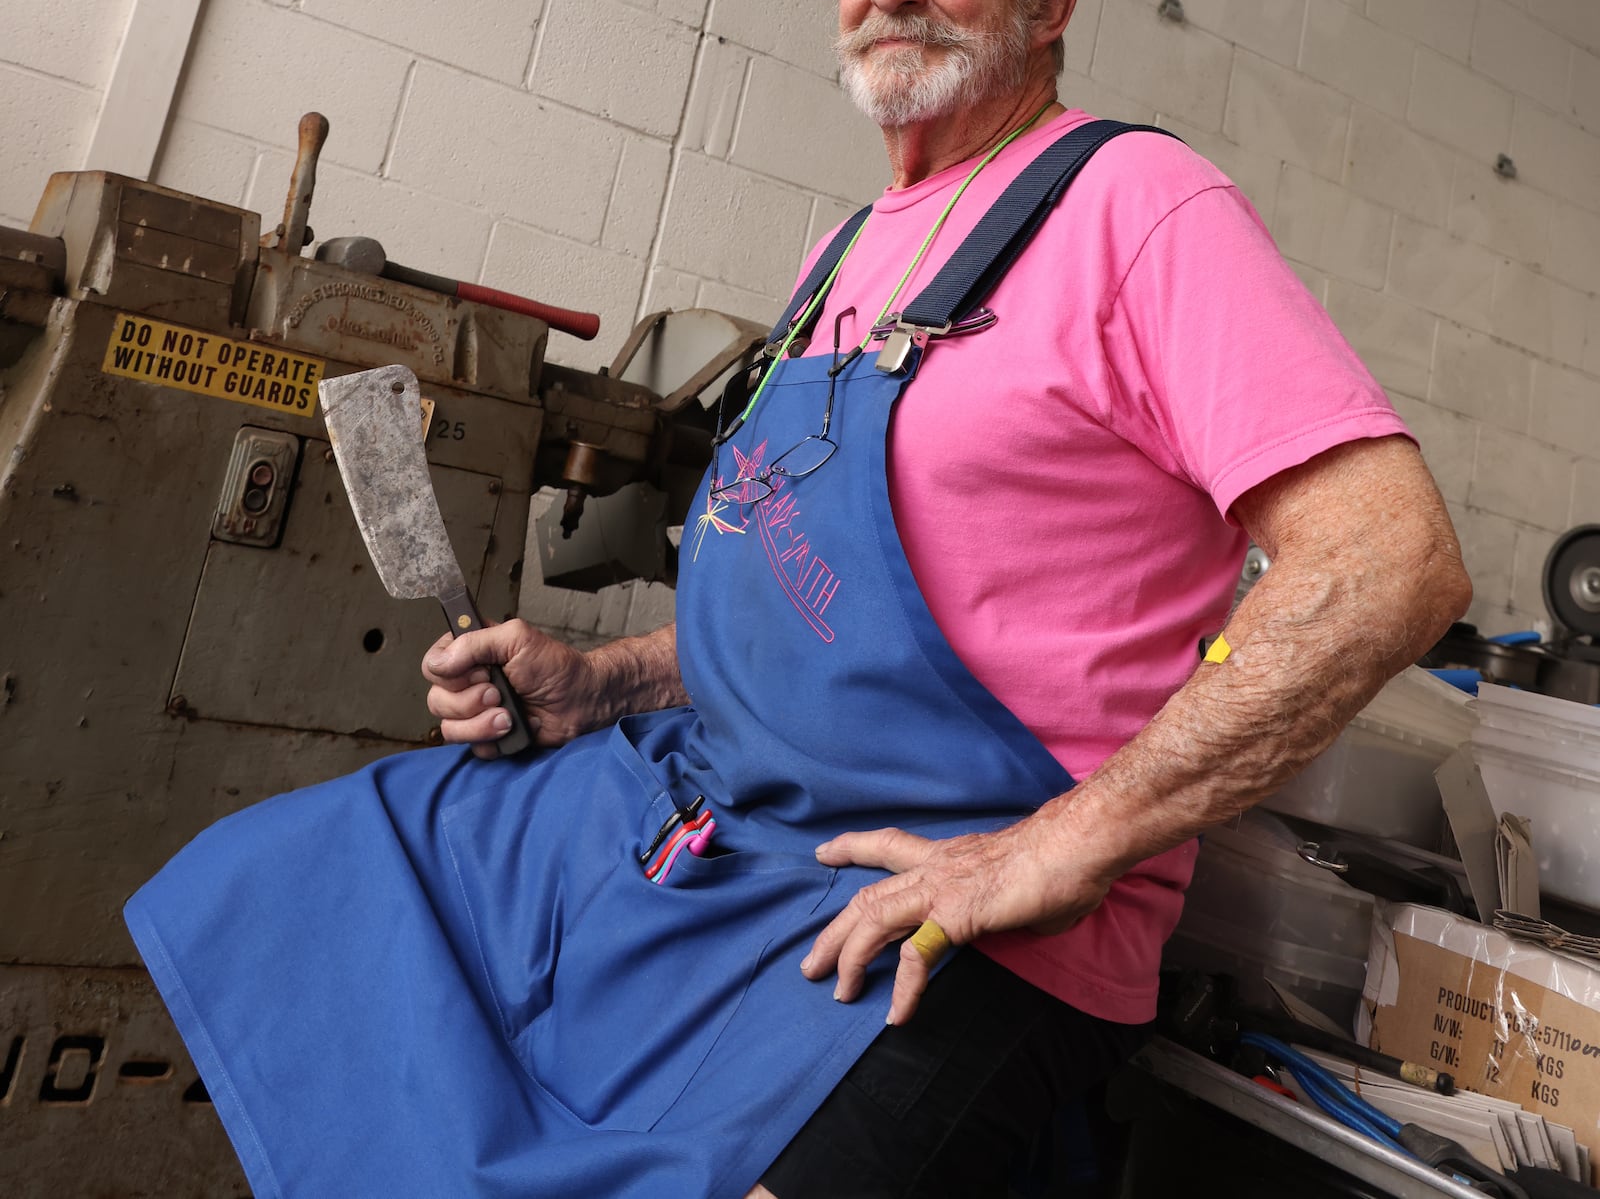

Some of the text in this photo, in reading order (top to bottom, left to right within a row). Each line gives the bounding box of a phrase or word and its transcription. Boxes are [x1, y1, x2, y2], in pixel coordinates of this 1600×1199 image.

[114, 346, 311, 410] WITHOUT GUARDS
[120, 320, 317, 385] DO NOT OPERATE
[437, 419, 465, 441] 25
[1437, 987, 1495, 1023] PRODUCT
[1430, 1040, 1460, 1068] G/W:
[1531, 1080, 1560, 1107] KGS
[1434, 1013, 1463, 1040] N/W:
[1536, 1053, 1565, 1079] KGS
